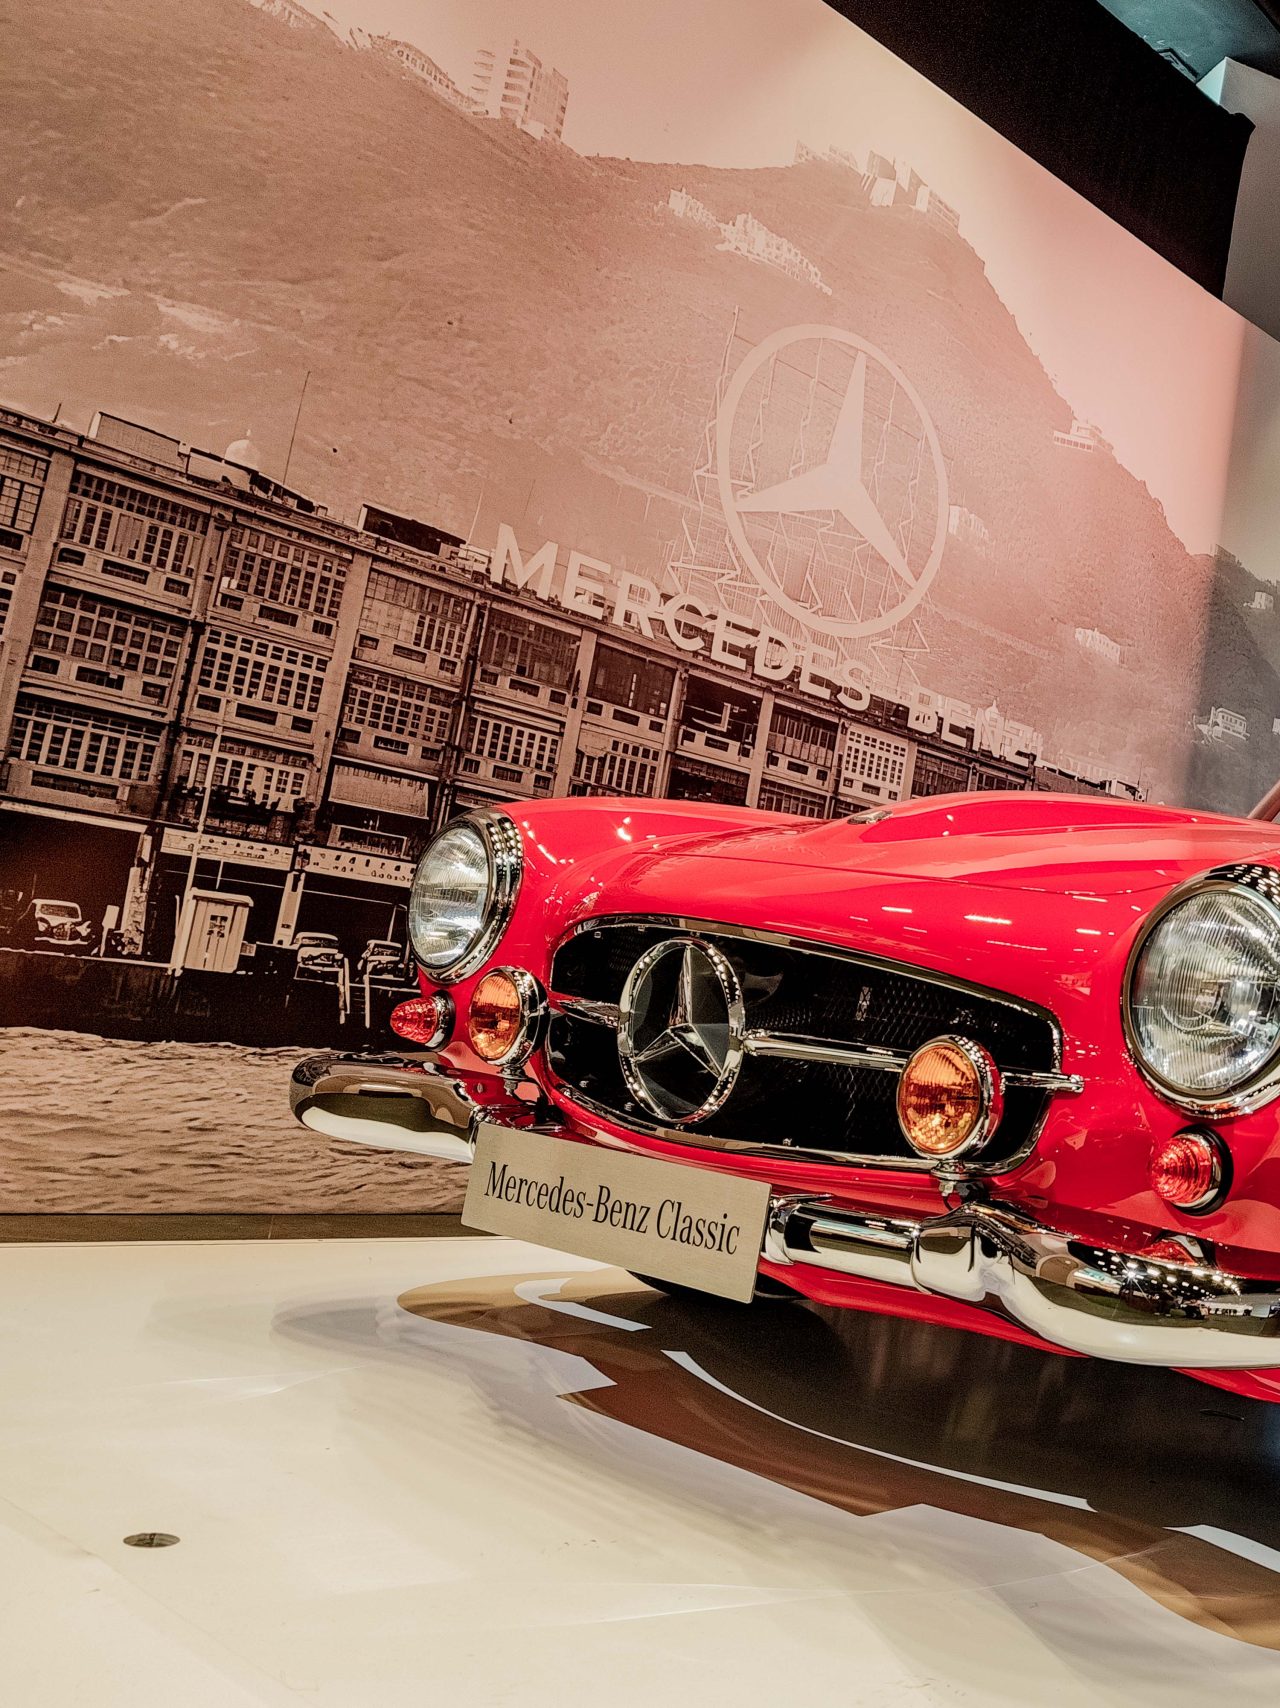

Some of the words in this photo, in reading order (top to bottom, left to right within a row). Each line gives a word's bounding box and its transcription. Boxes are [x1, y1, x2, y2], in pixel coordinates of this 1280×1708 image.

[490, 522, 873, 711] MERCEDES
[483, 1160, 651, 1235] Mercedes-Benz
[656, 1198, 741, 1255] Classic
